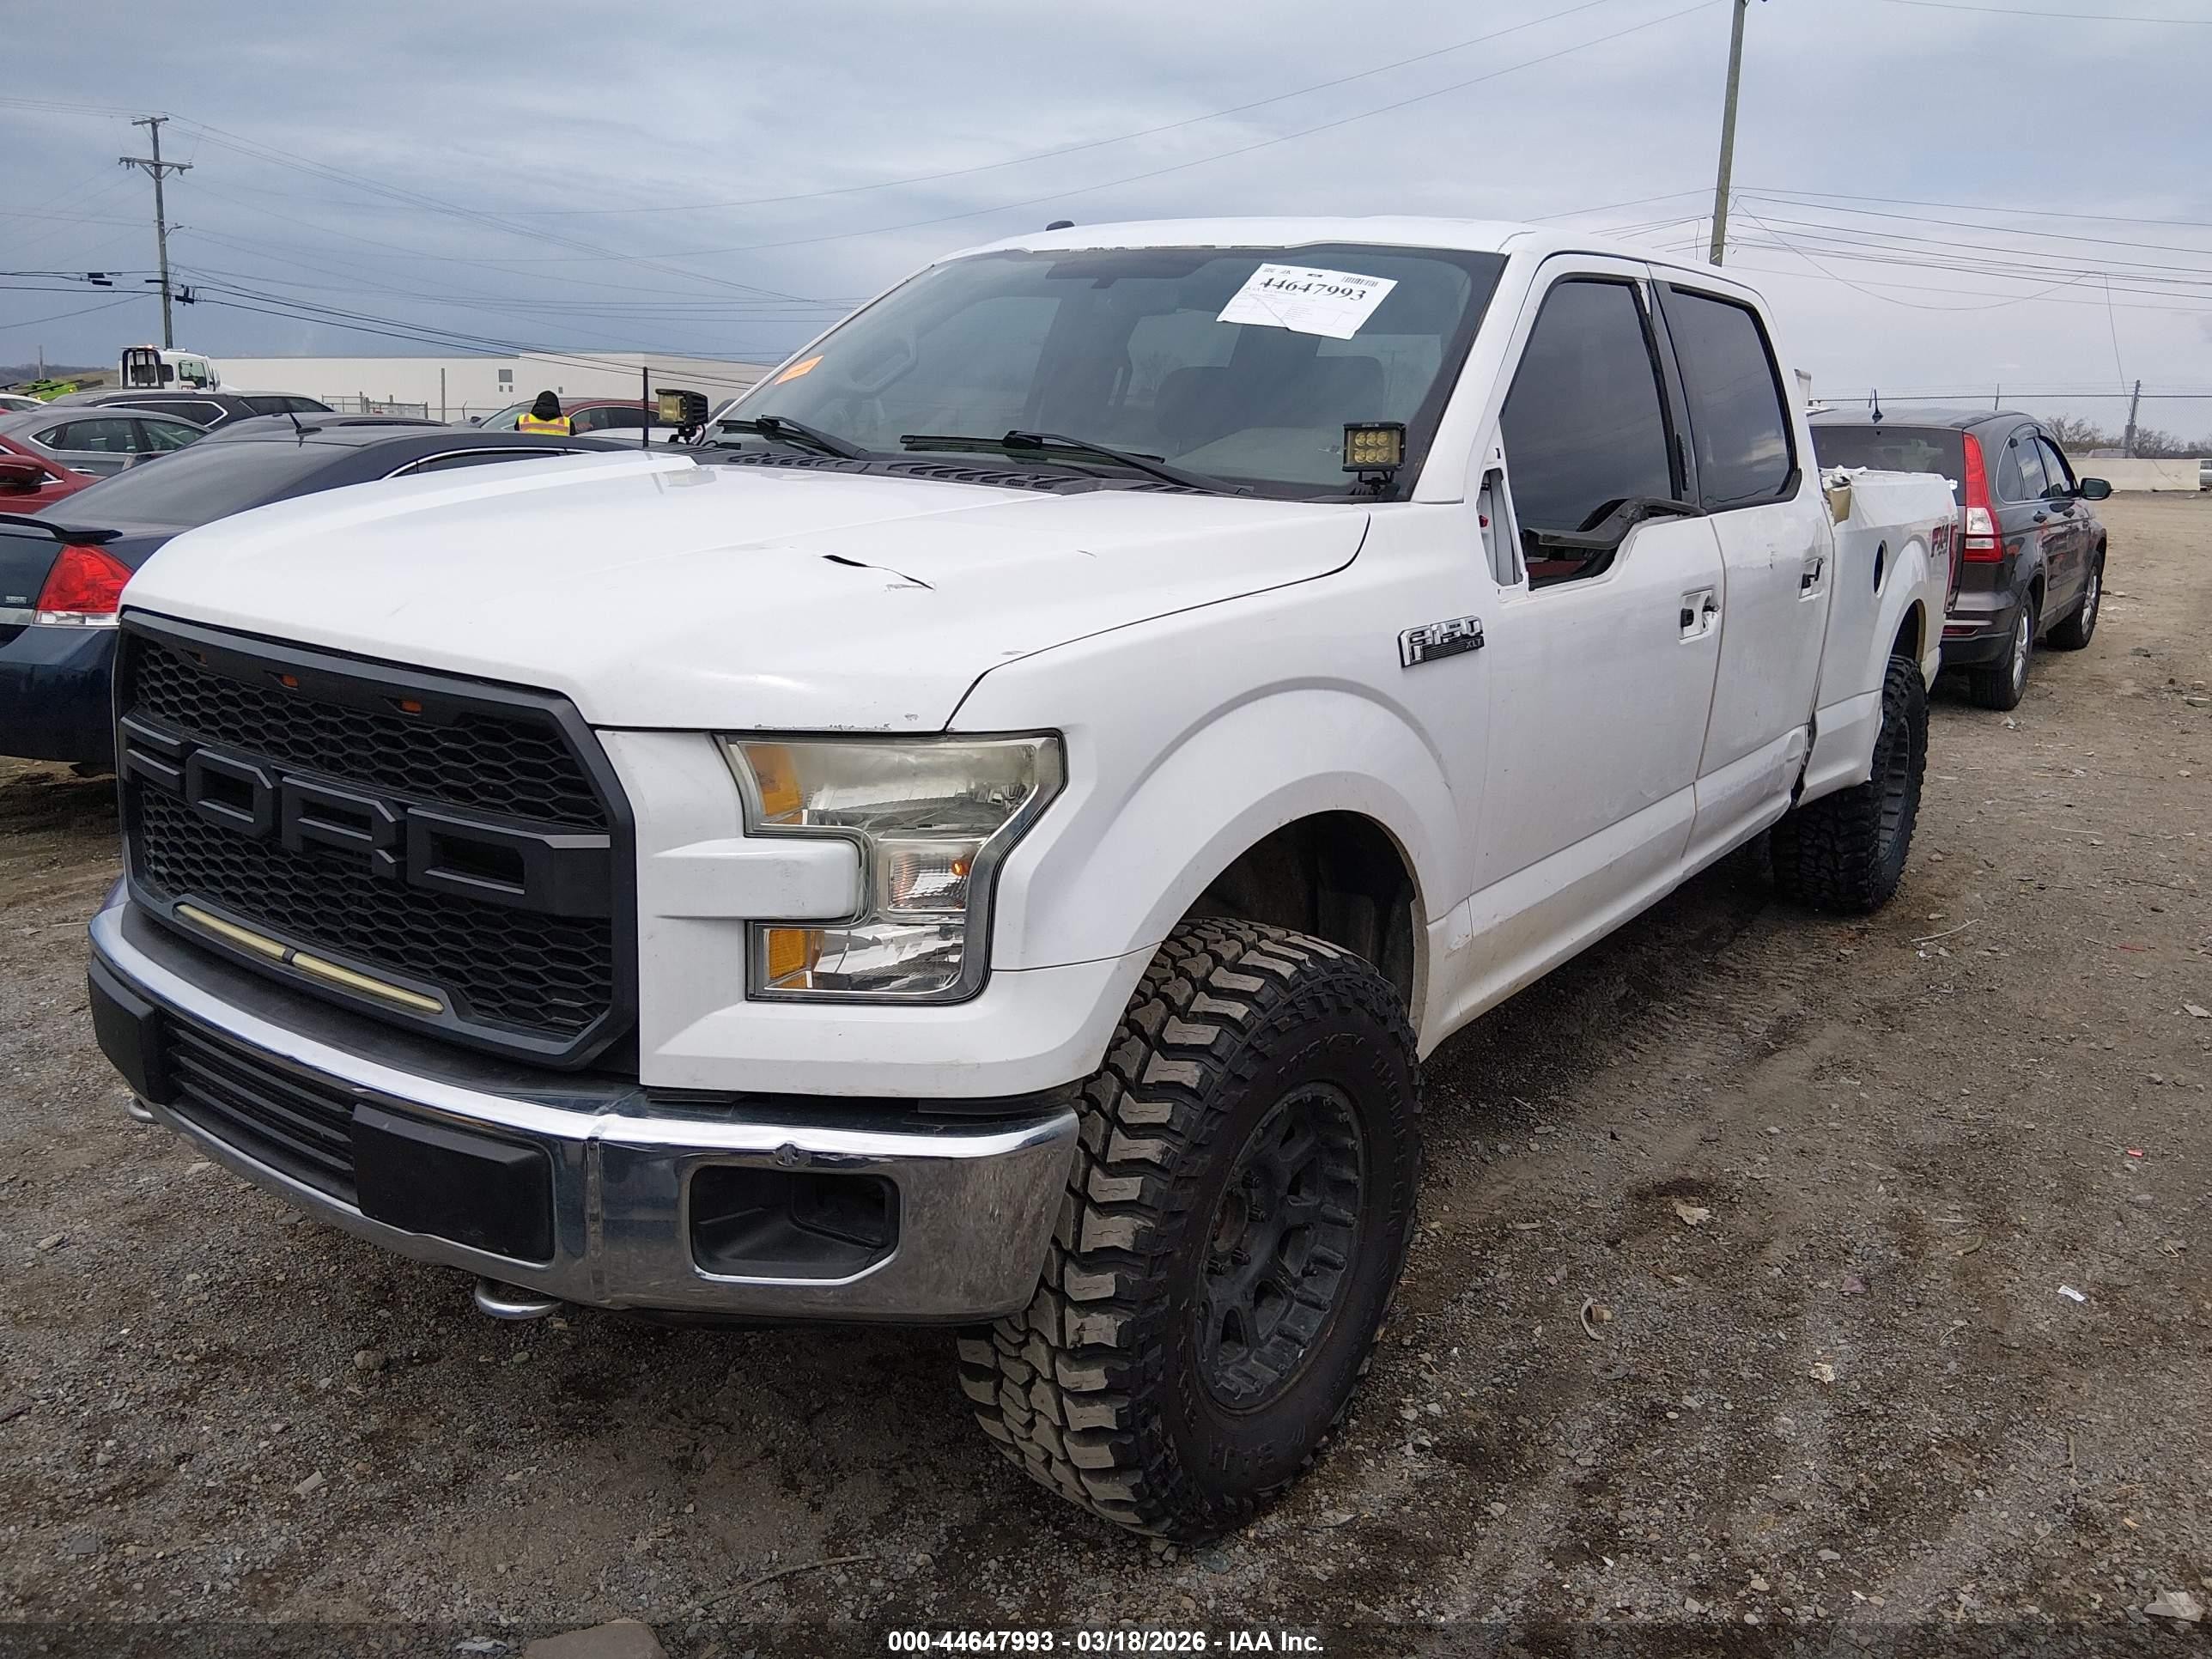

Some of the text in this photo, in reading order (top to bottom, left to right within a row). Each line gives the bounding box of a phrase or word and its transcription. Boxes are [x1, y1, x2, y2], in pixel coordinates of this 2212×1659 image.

[1259, 276, 1367, 301] 44647993
[1466, 637, 1483, 650] XLT
[118, 711, 541, 898] FORD
